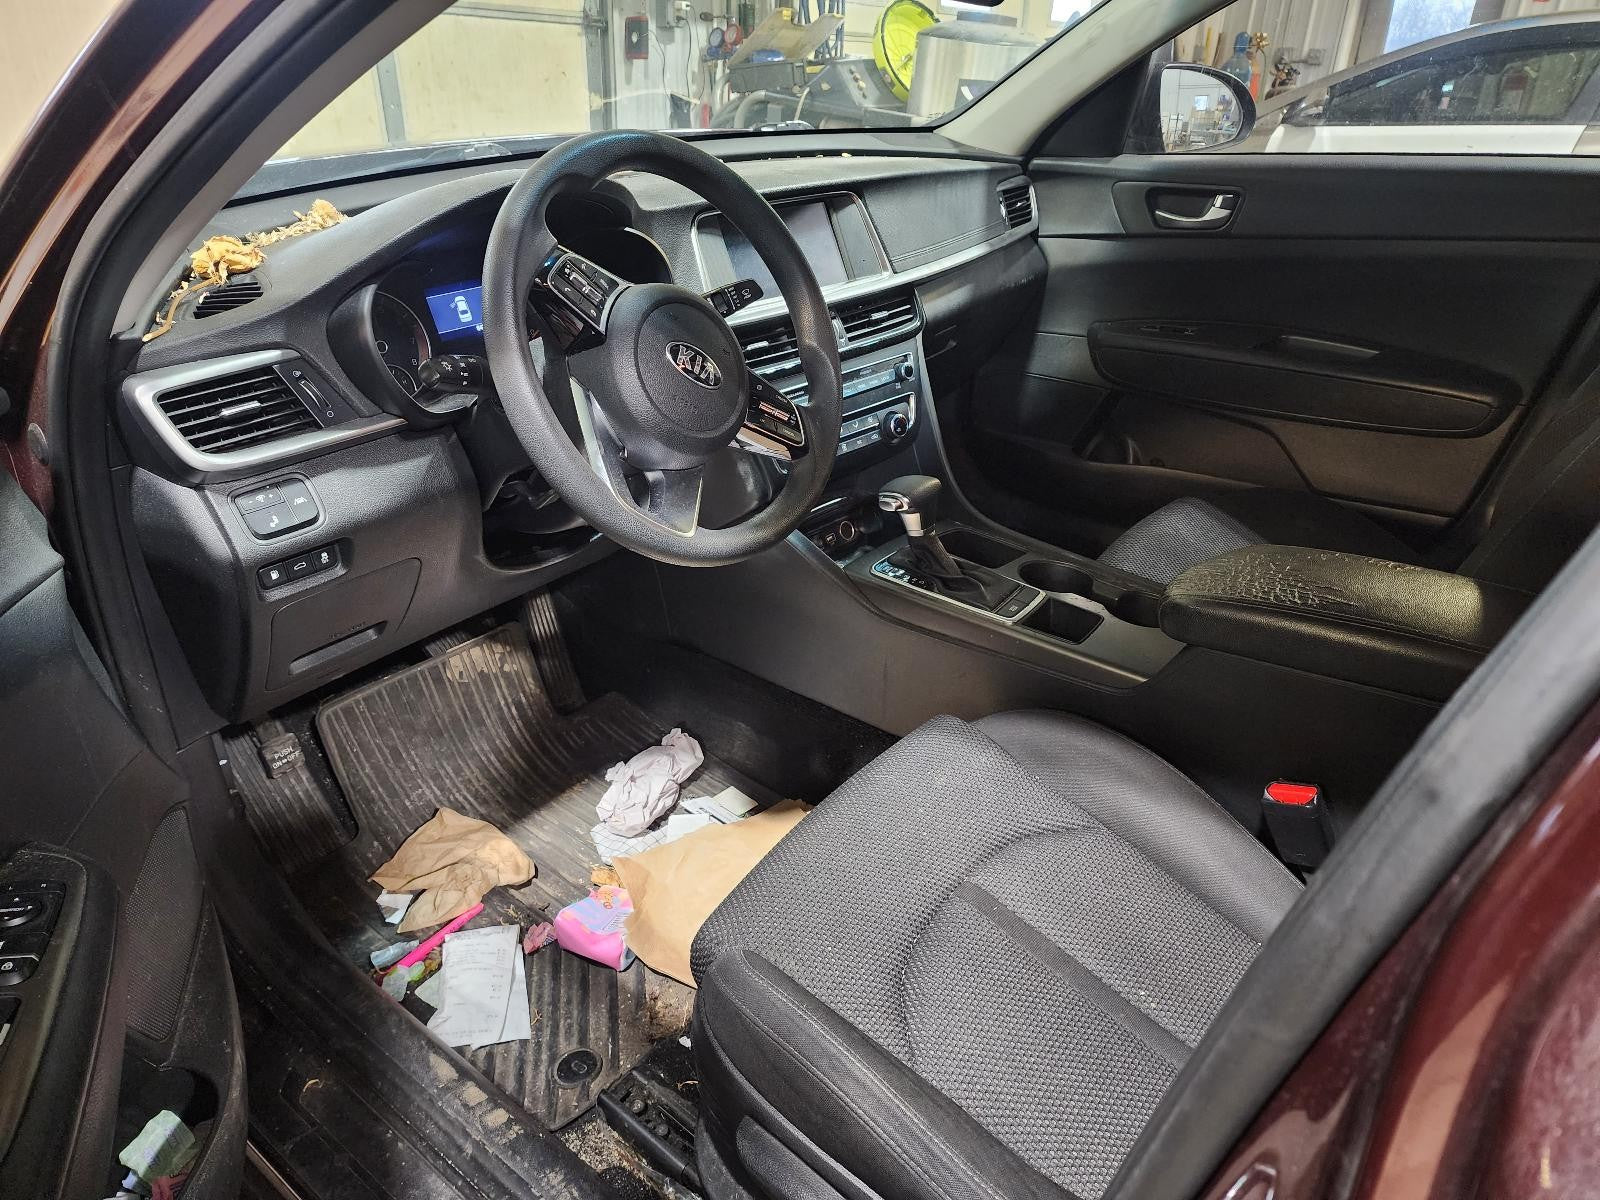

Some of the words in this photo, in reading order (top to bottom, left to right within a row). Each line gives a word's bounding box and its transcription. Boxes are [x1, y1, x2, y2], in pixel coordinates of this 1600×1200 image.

[676, 344, 716, 386] KIA
[271, 760, 283, 770] ON
[286, 750, 300, 761] OFF
[273, 745, 293, 759] PUSH
